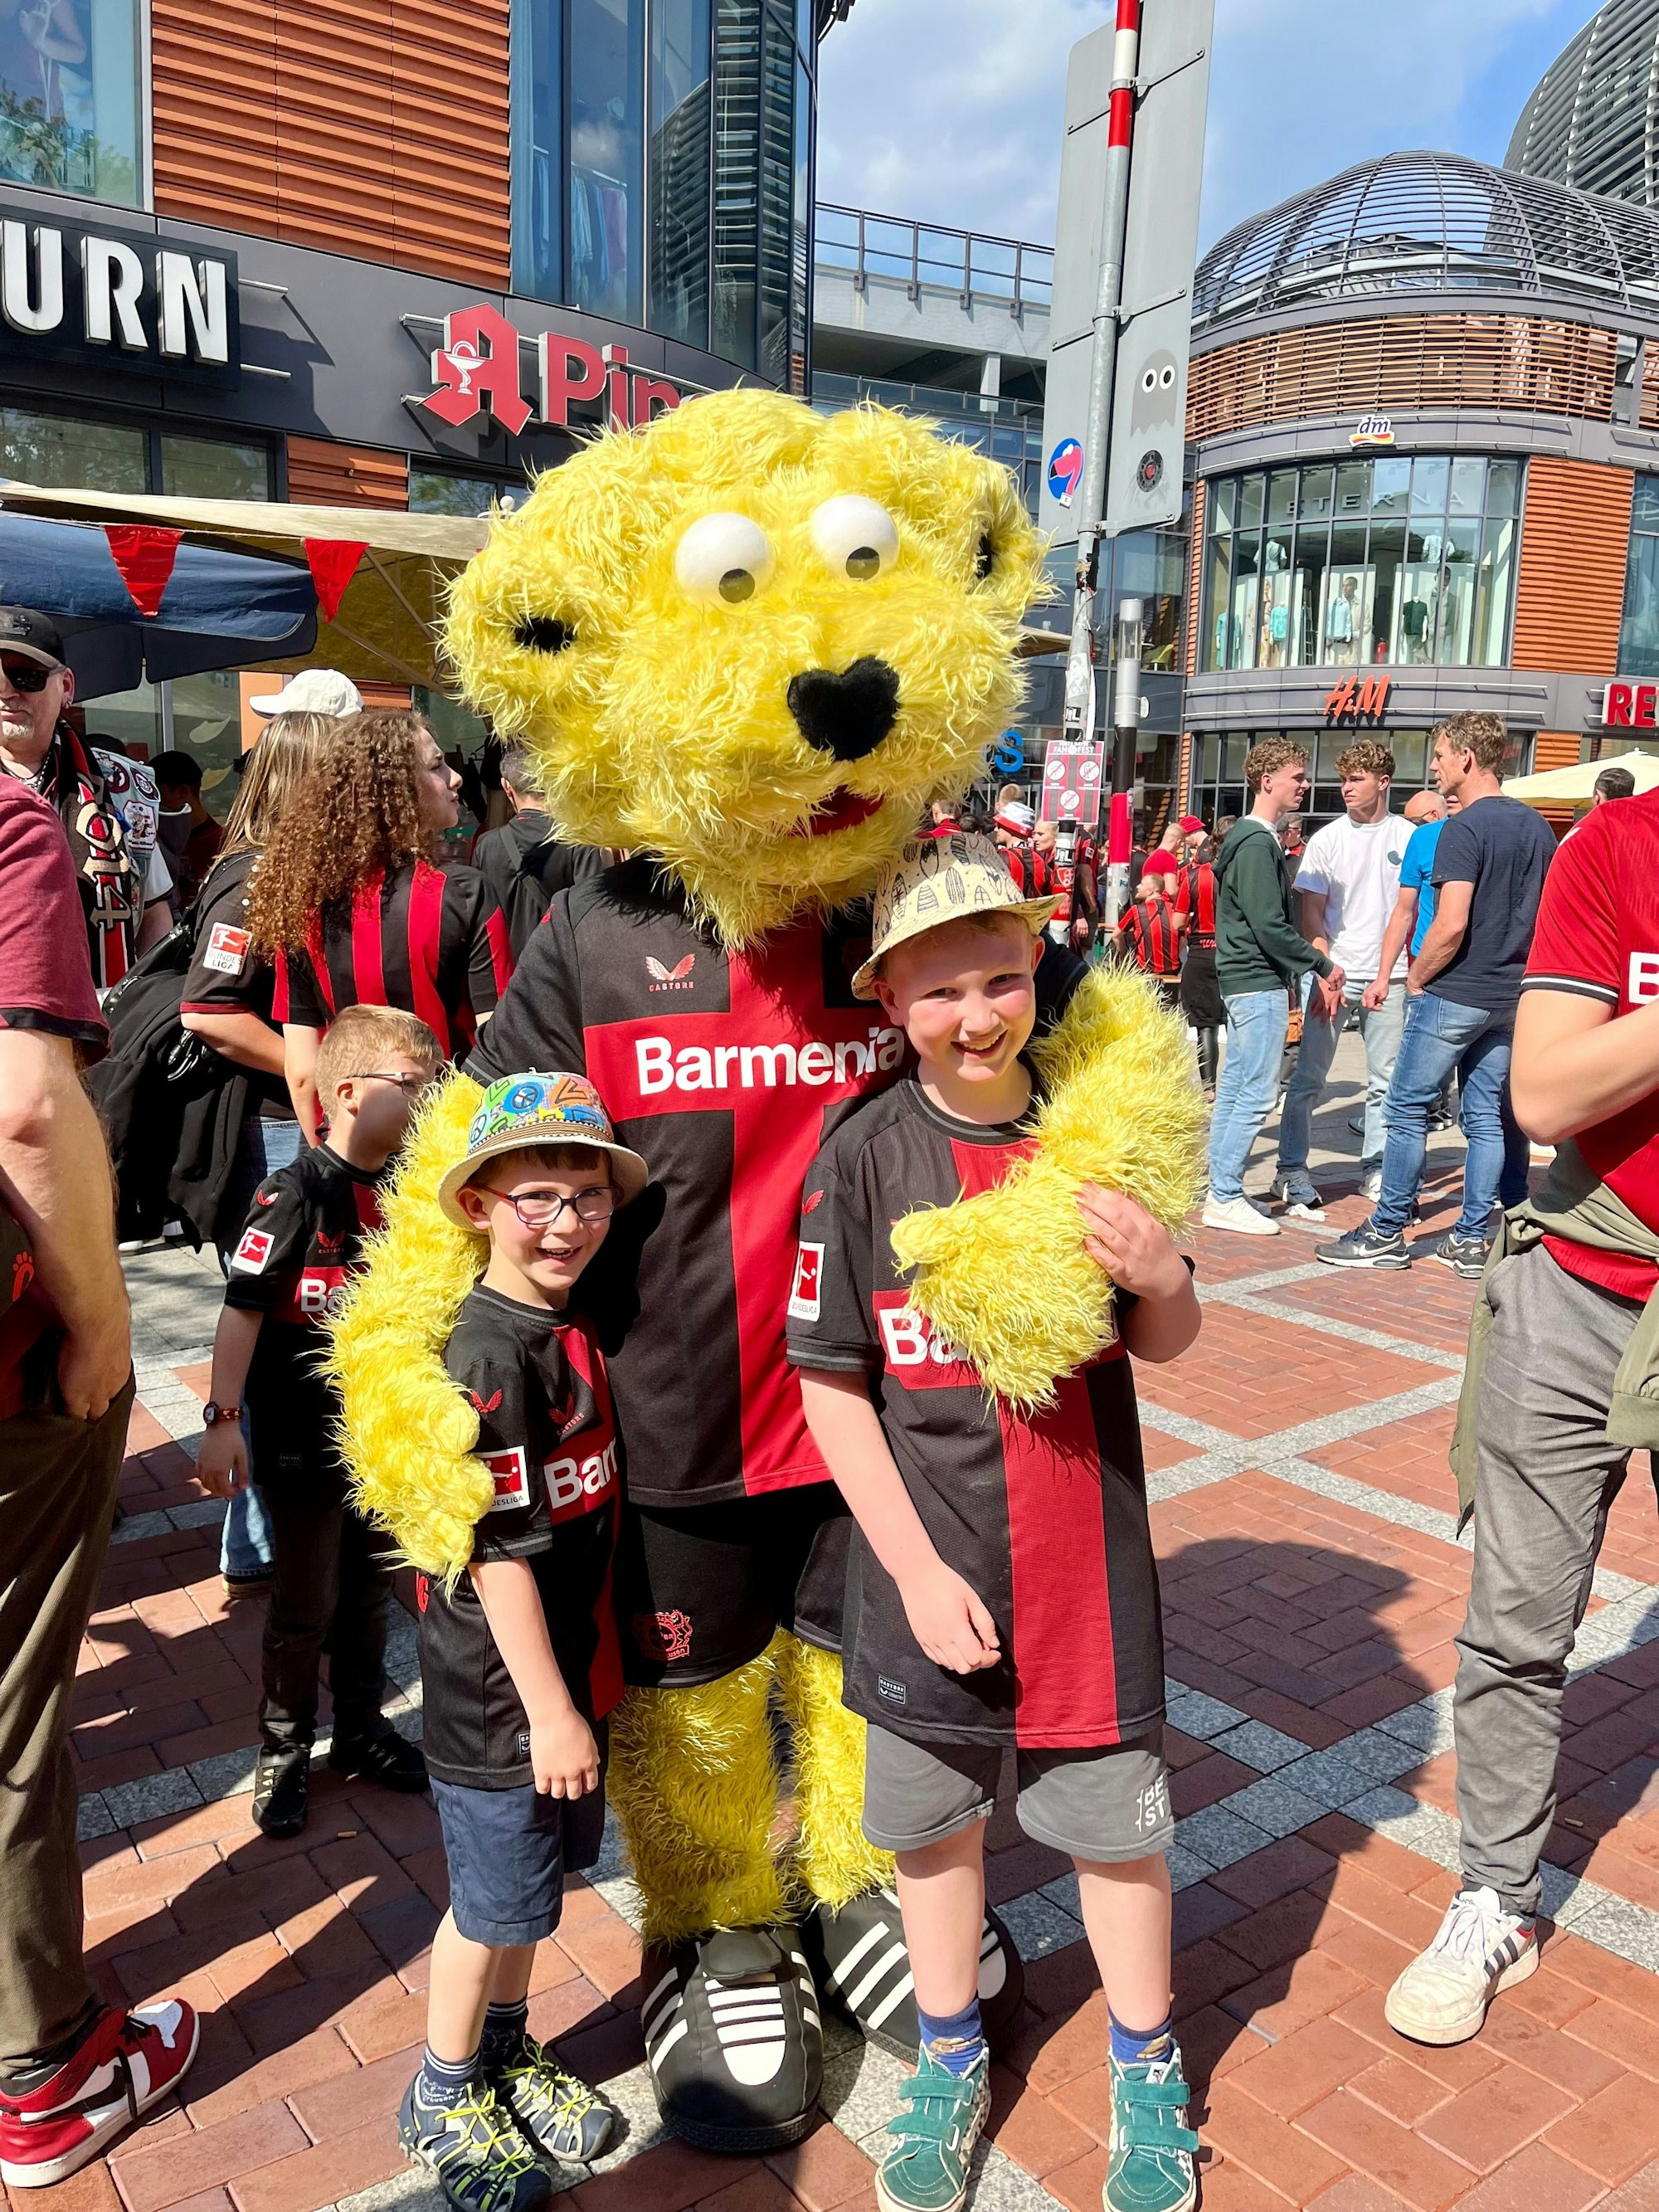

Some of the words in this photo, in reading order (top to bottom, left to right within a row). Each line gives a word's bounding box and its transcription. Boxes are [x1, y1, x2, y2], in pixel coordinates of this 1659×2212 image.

[1, 219, 228, 364] URN
[539, 331, 702, 436] Pin
[1359, 417, 1389, 433] dm
[1287, 490, 1465, 515] ETERNA
[1323, 674, 1391, 718] H&M
[212, 959, 233, 970] LIGA
[649, 981, 694, 992] CASTORE
[635, 1026, 905, 1096] Barmenia
